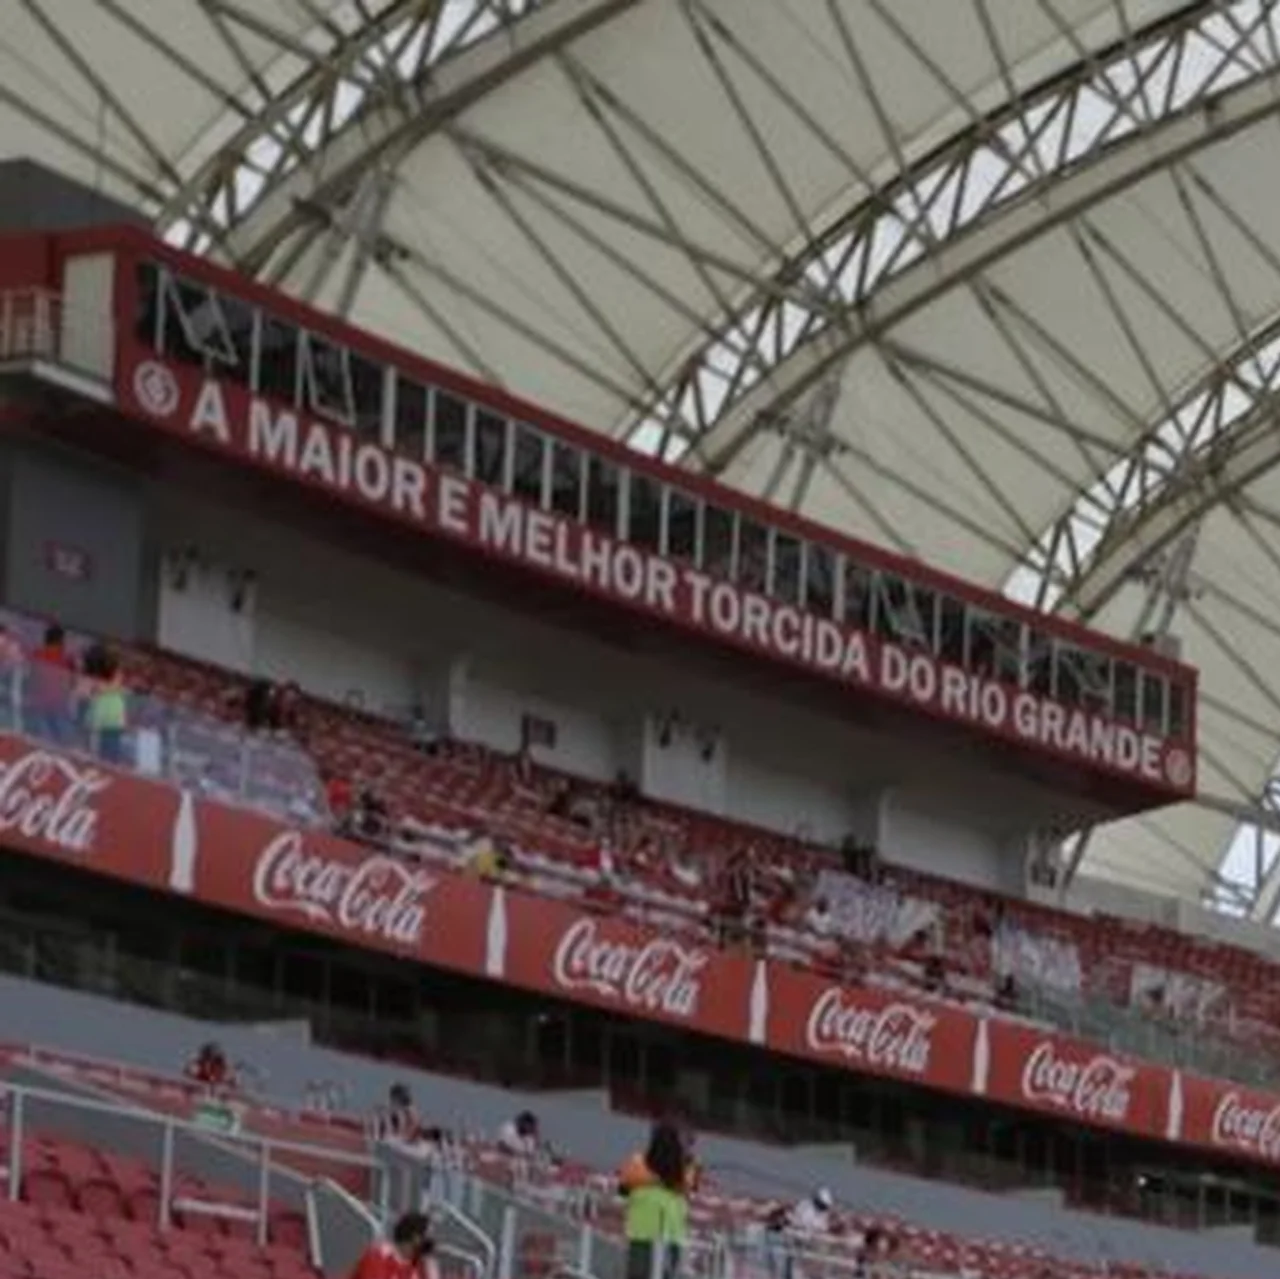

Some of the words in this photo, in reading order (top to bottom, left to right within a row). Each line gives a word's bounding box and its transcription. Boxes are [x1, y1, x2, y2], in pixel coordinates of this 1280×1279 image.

[188, 379, 230, 443] A
[248, 398, 427, 520] MAIOR
[438, 475, 470, 534] E
[477, 492, 679, 614] MELHOR
[682, 569, 872, 684] TORCIDA
[880, 644, 936, 701] DO
[939, 665, 1008, 726] RIO
[1012, 692, 1165, 780] GRANDE
